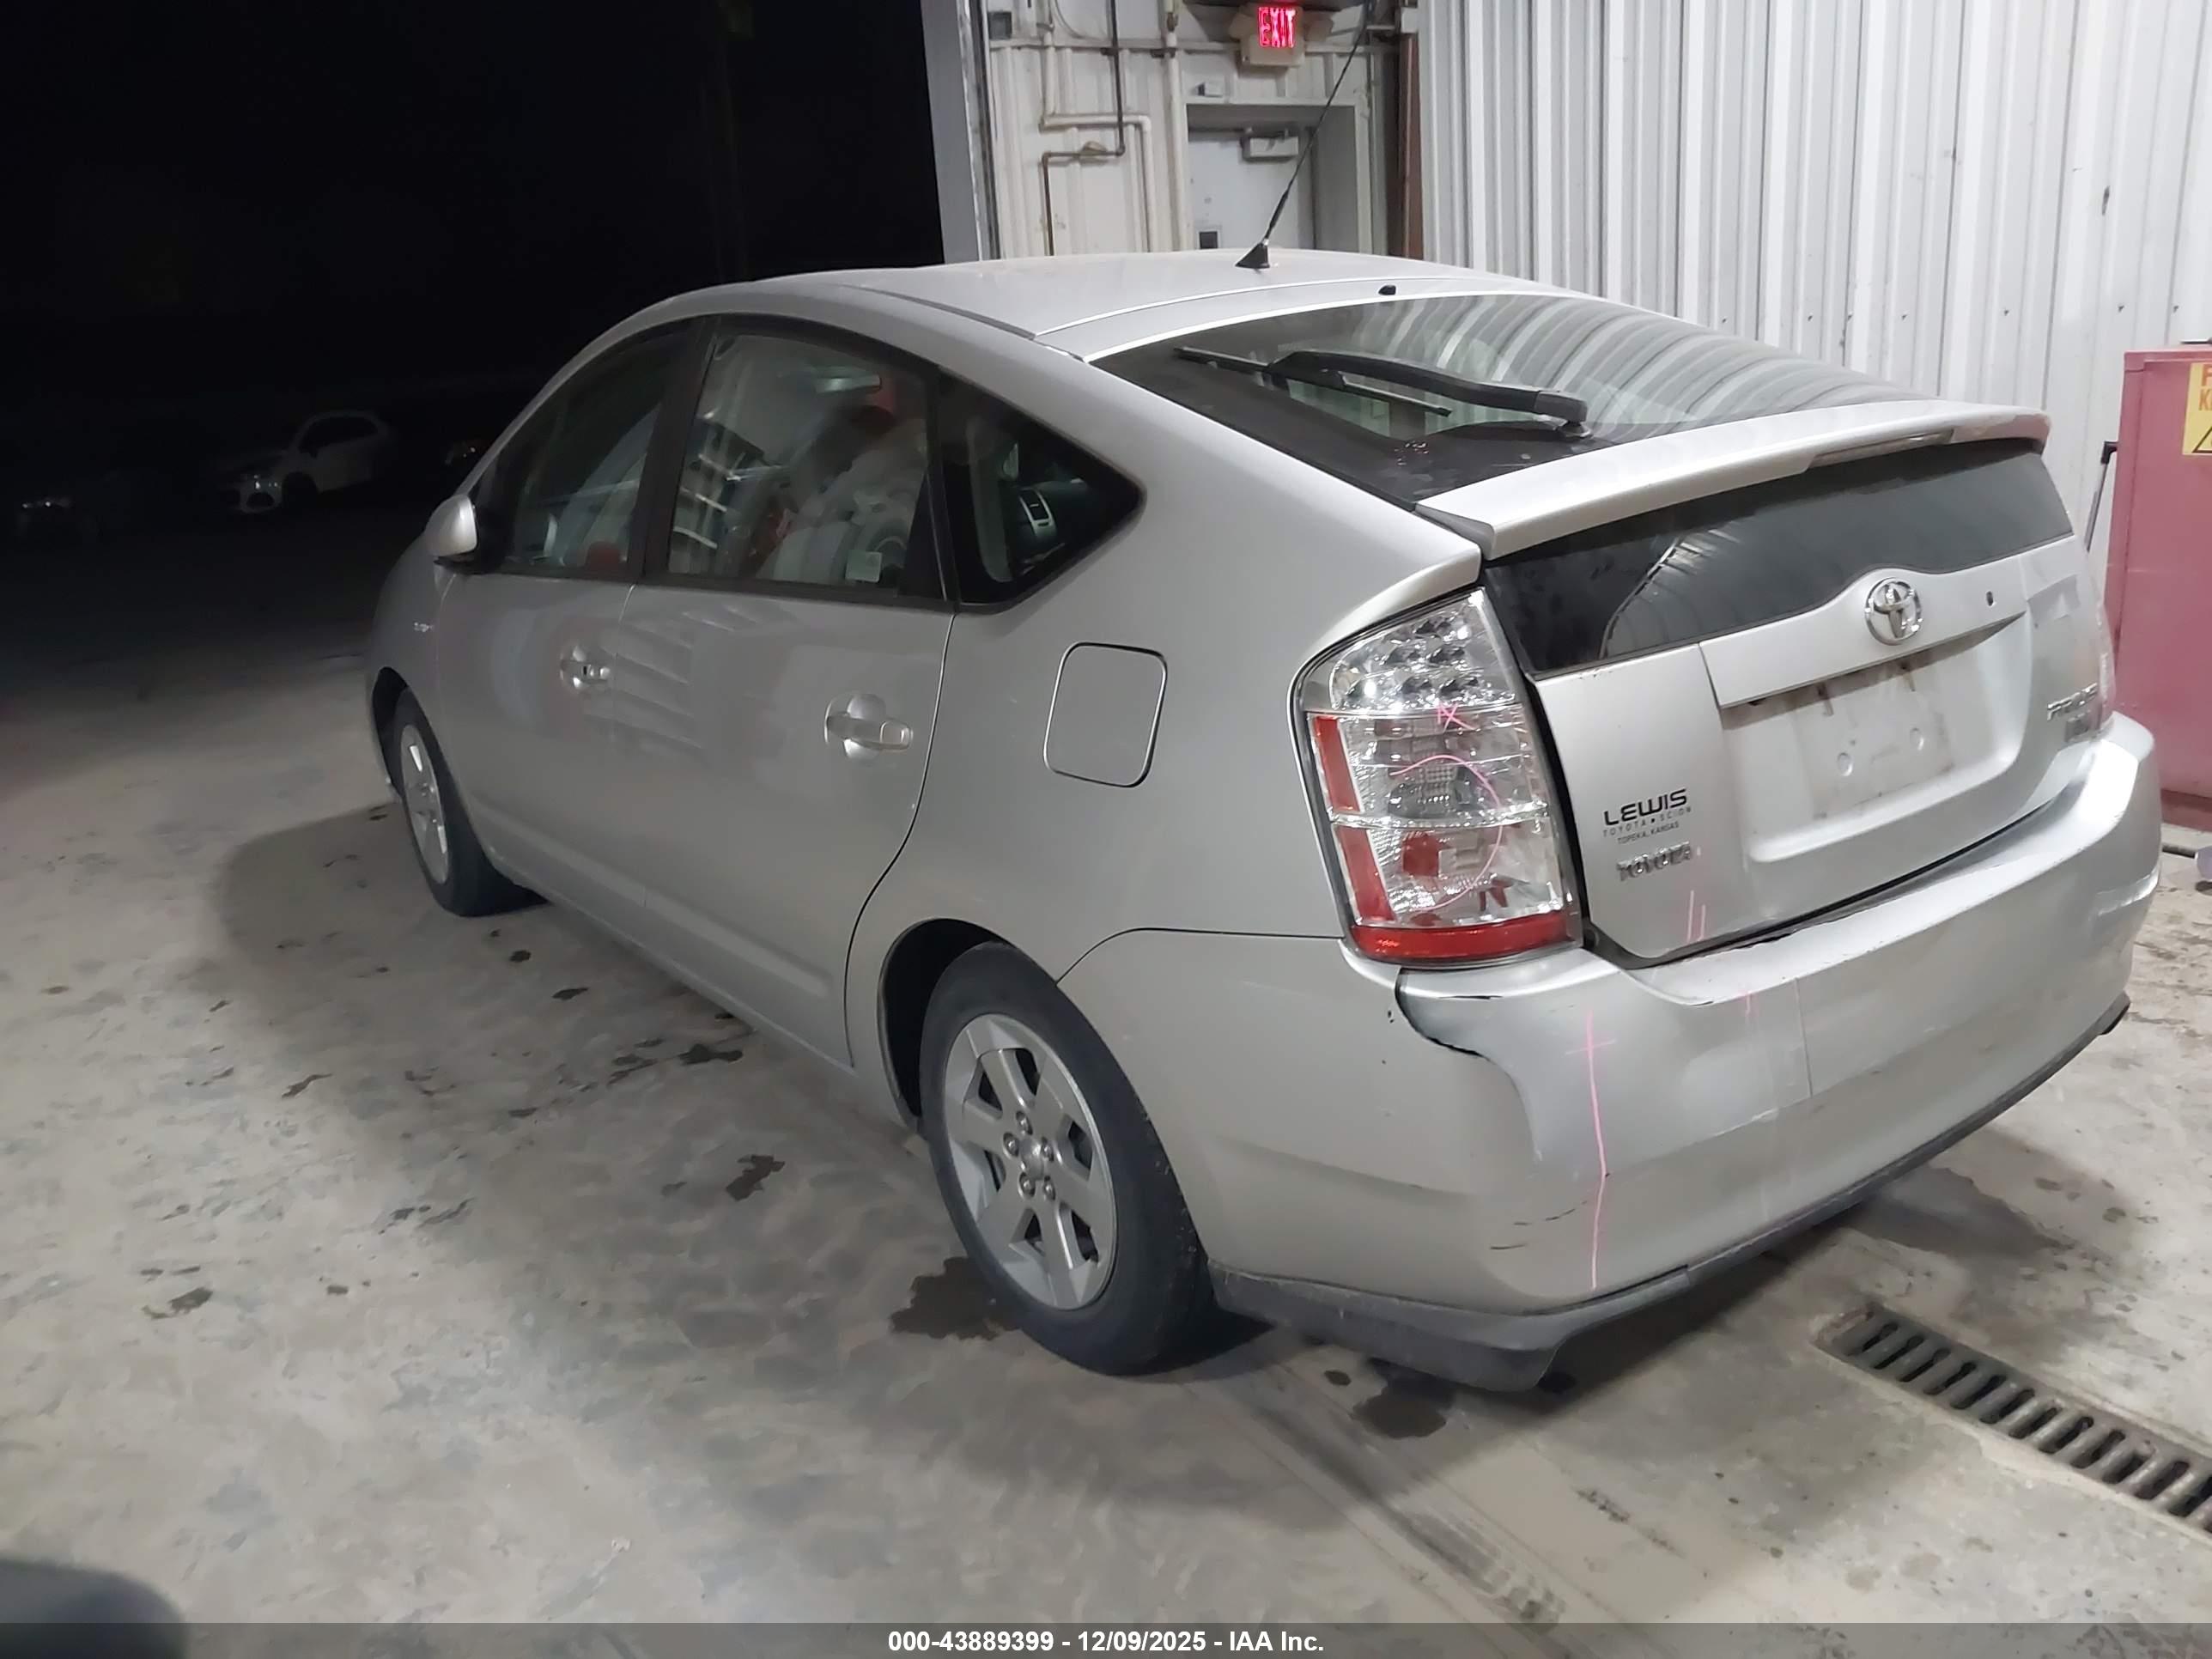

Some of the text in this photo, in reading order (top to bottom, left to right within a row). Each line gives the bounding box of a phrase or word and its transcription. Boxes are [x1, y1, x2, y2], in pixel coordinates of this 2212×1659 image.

[1258, 7, 1296, 47] EXIT
[2198, 389, 2212, 410] K
[1604, 788, 1687, 826] LEWIS
[1603, 818, 1646, 837] TOYOTA
